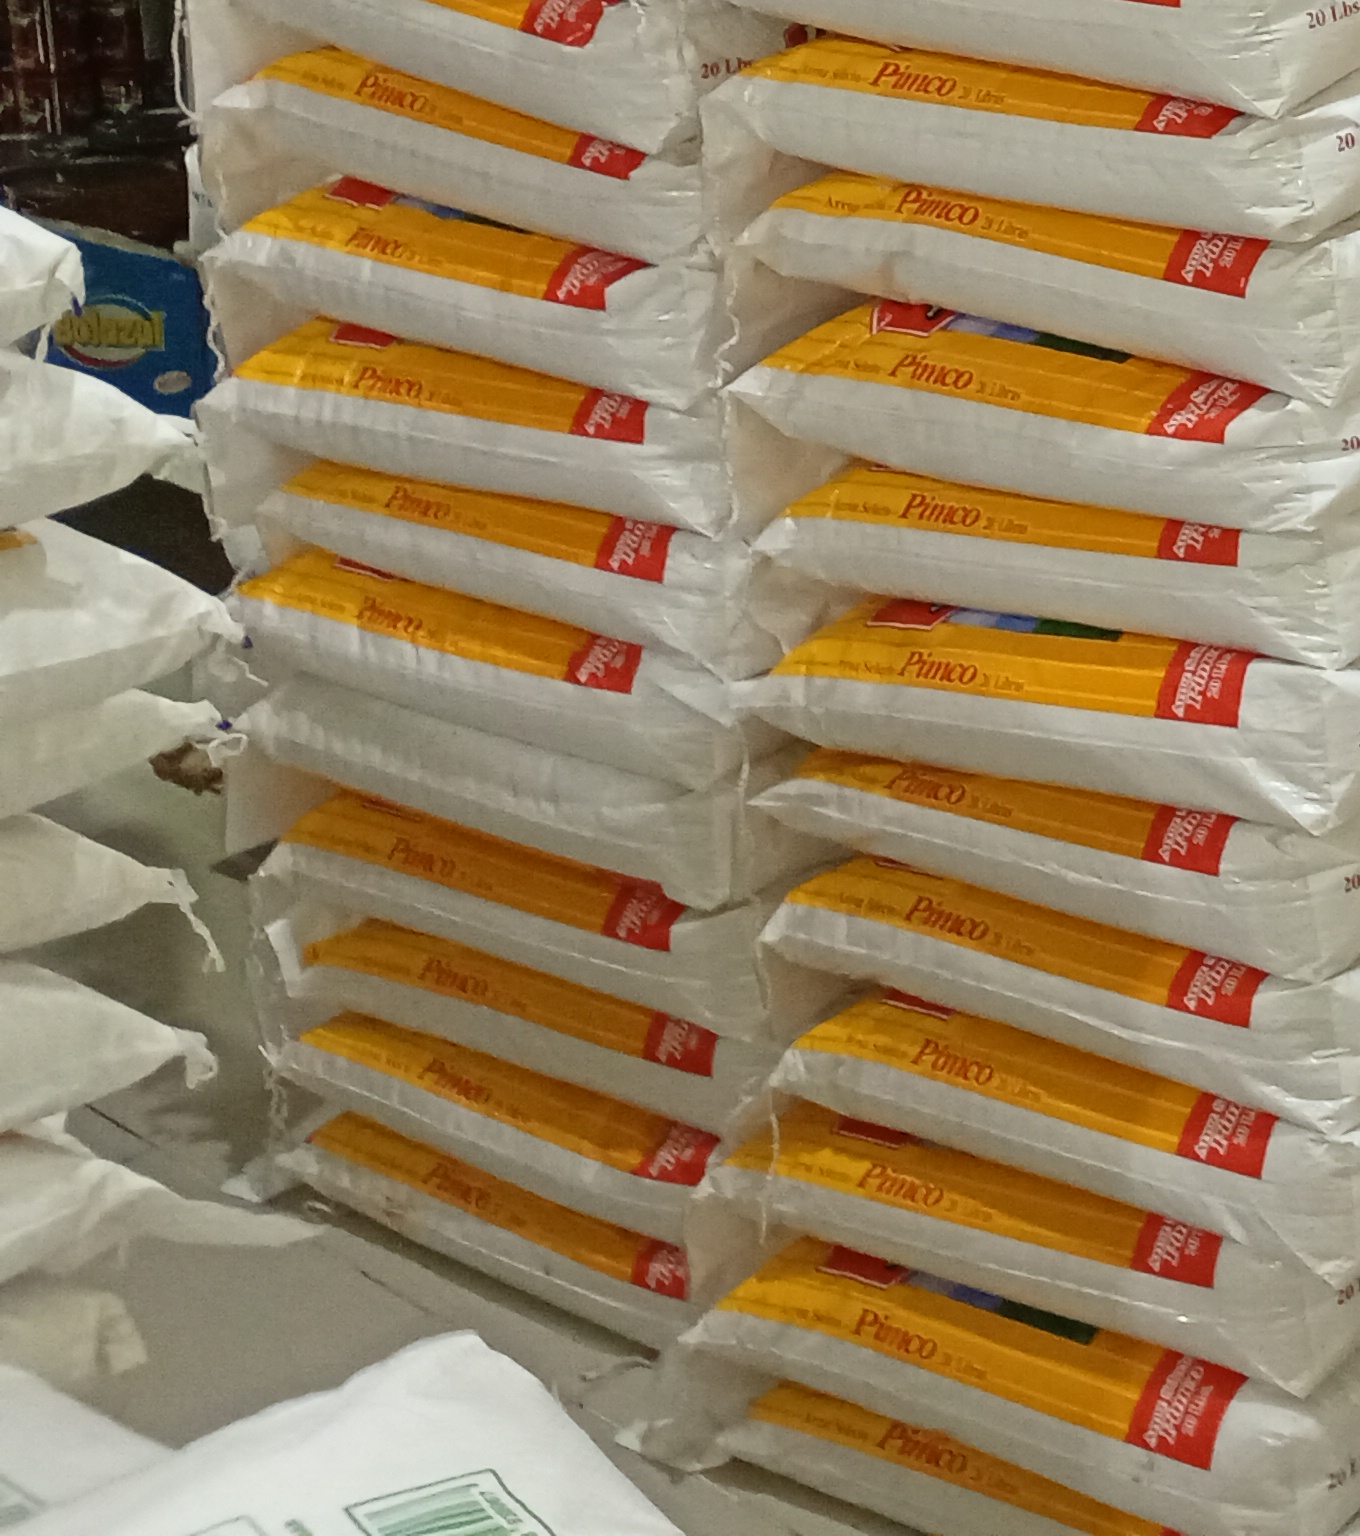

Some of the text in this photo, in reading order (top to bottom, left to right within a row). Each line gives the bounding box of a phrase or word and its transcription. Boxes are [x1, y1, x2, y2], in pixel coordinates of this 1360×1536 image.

[1306, 9, 1326, 29] 20
[1336, 132, 1355, 152] 20
[899, 492, 981, 528] Pimco
[905, 895, 990, 943] Pimco
